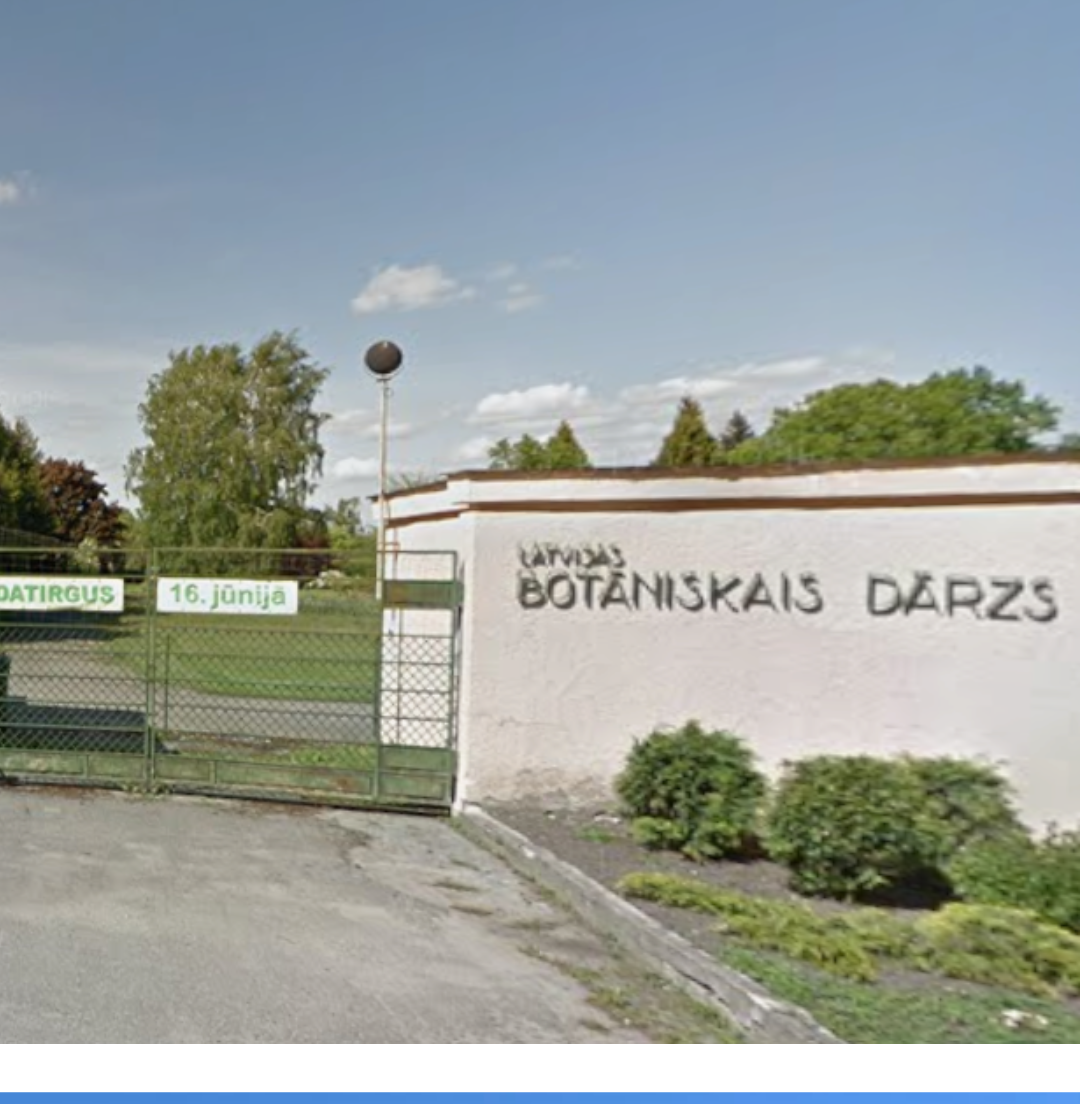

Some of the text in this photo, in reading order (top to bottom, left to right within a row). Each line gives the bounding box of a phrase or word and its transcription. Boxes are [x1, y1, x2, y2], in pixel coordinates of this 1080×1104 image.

[519, 542, 626, 568] LATVIJAS
[170, 584, 286, 610] 16. jūnijā
[518, 570, 1058, 622] BOTĀNISKAIS DĀRZS
